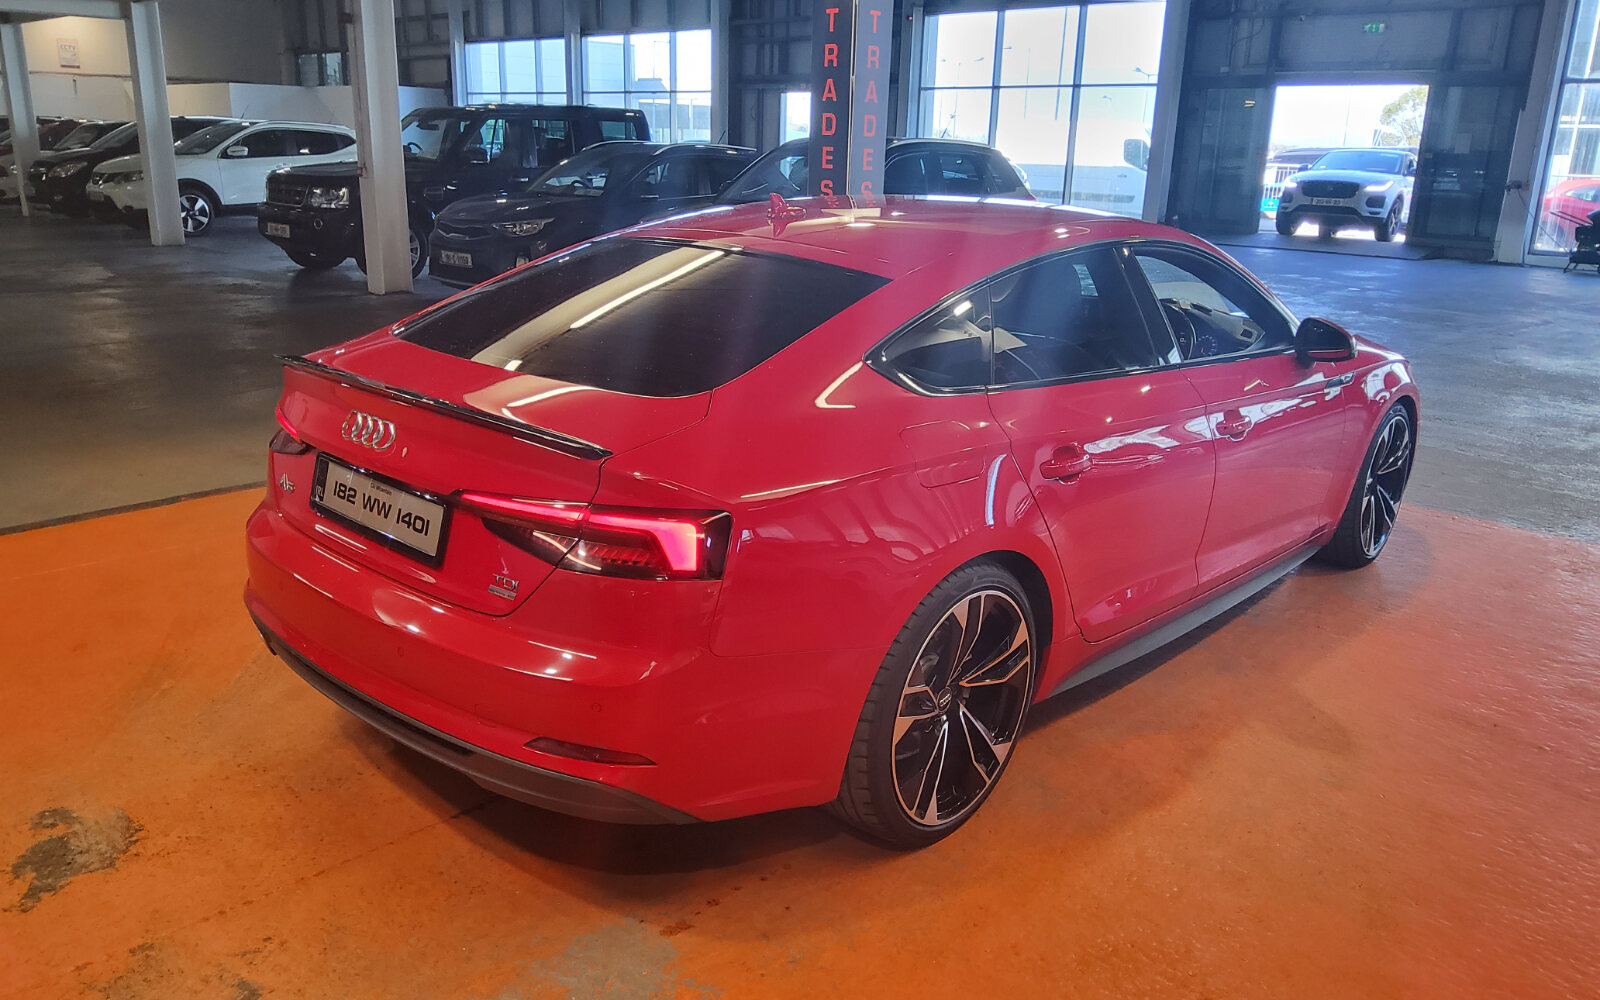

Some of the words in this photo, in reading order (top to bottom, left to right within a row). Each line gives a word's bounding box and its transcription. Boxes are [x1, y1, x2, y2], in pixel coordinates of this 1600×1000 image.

[821, 8, 840, 197] TRADES
[861, 10, 882, 198] TRADES
[279, 473, 295, 493] A5
[333, 480, 357, 505] 182
[362, 493, 392, 519] WW
[396, 508, 430, 536] 1401
[492, 573, 519, 592] TDI
